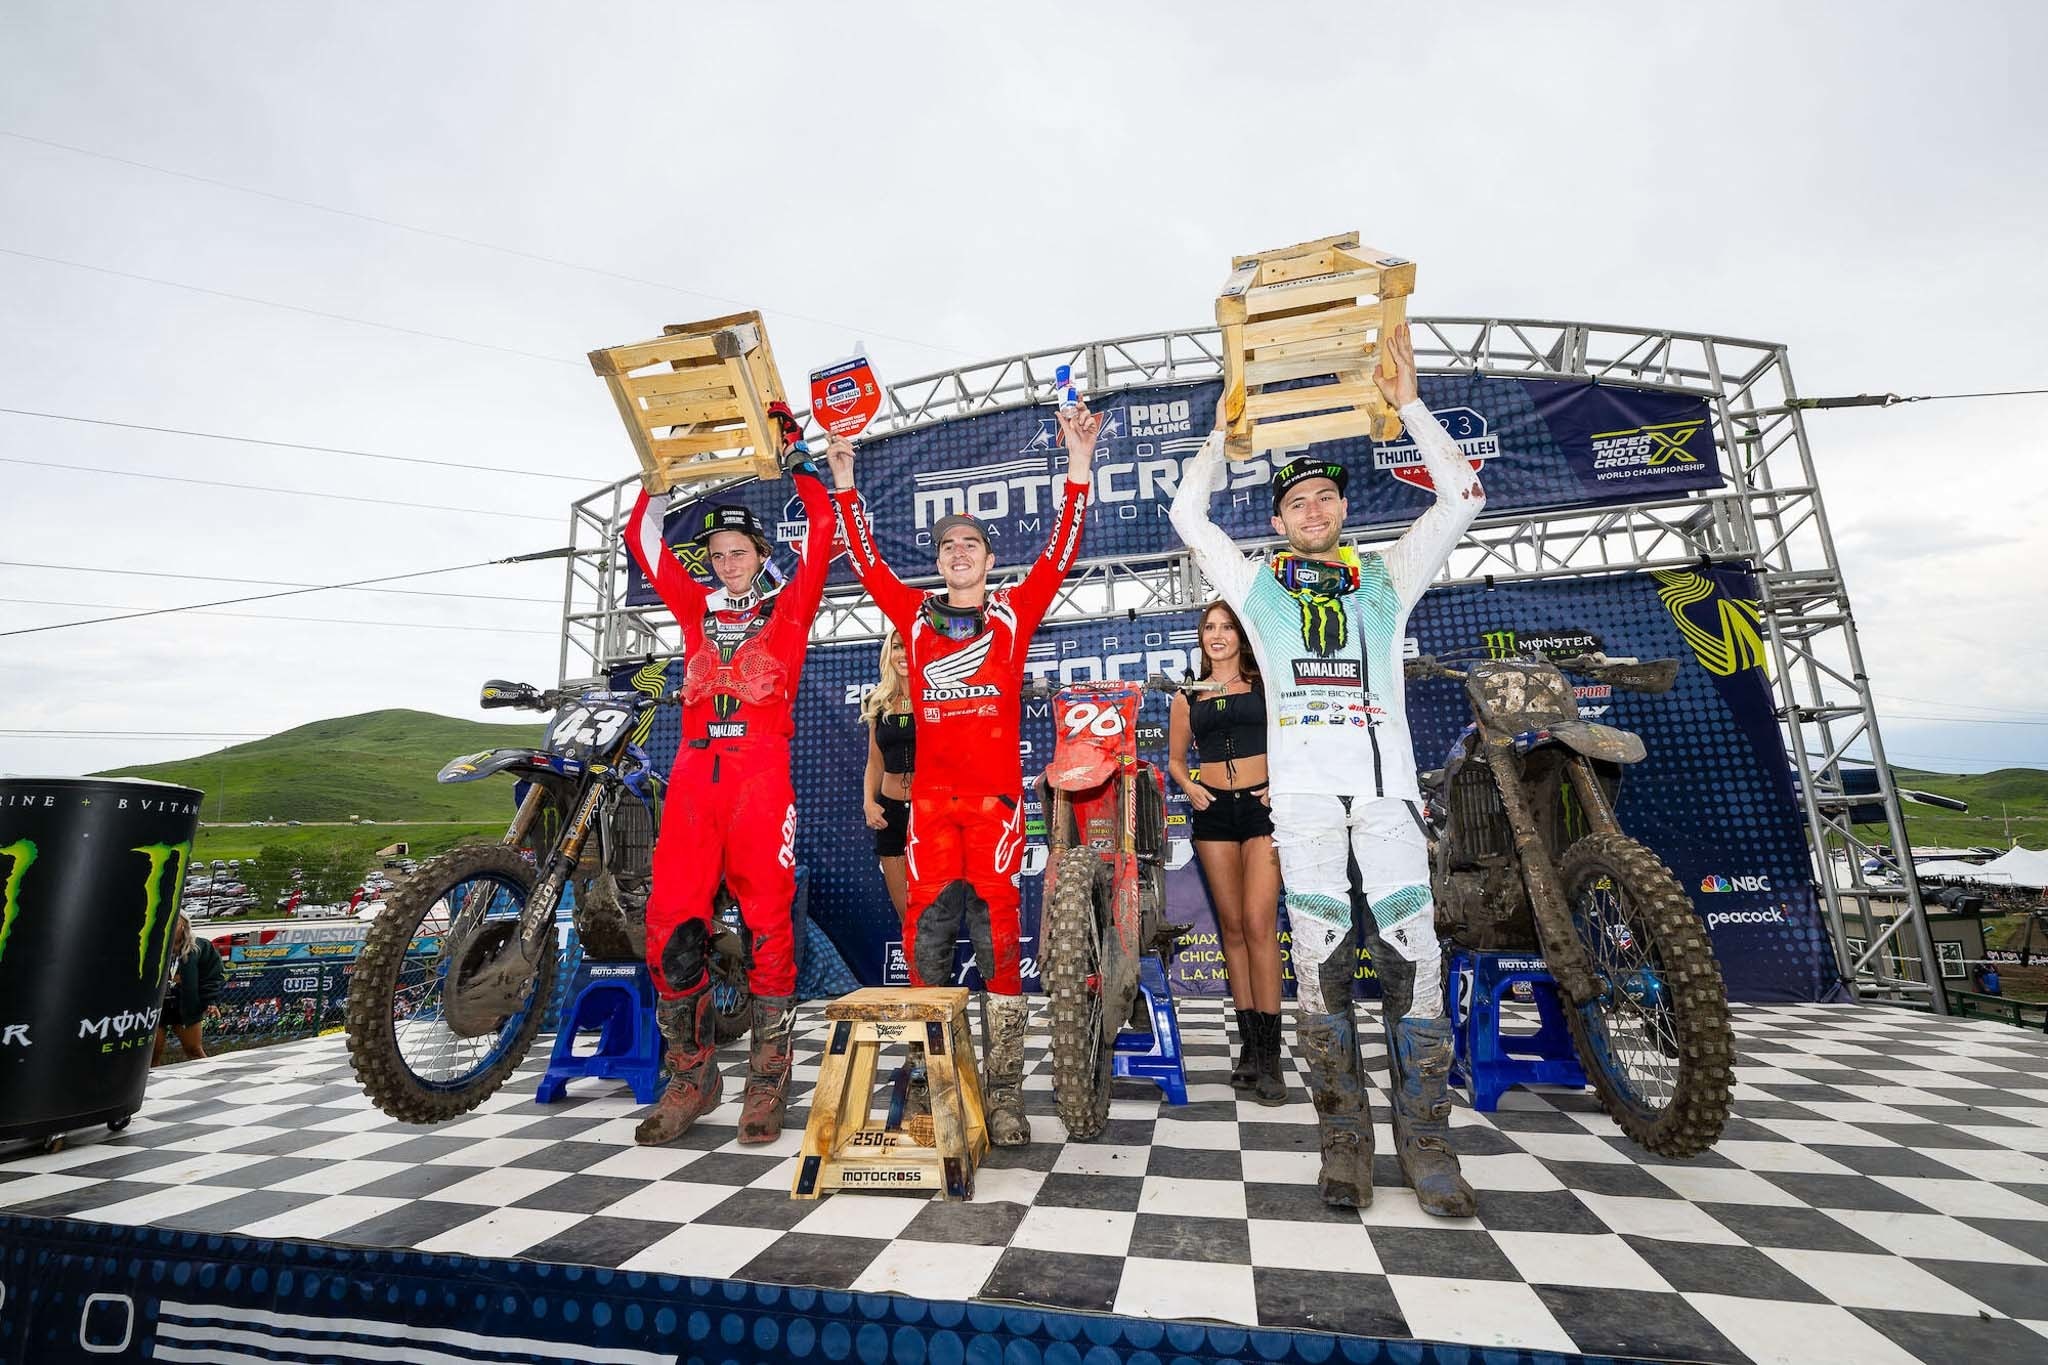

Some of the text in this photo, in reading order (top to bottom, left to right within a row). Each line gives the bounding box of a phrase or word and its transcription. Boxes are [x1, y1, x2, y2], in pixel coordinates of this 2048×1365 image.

[1130, 400, 1190, 426] PRO
[1132, 421, 1191, 437] RACING
[1592, 435, 1652, 451] SUPER
[1597, 445, 1650, 459] MOTO
[1594, 455, 1652, 469] CROSS
[1597, 463, 1706, 480] WORLD CHAMPIONSHIP
[914, 441, 1311, 530] MOTOCRSS
[850, 502, 876, 568] HONDA
[1045, 495, 1068, 560] HONDA
[716, 633, 746, 641] THOR
[1062, 633, 1162, 655] PRO
[1295, 662, 1358, 678] YAMALUBE
[922, 684, 1001, 701] HONDA
[1328, 690, 1380, 701] BICYCLES
[552, 707, 628, 746] 43
[1064, 703, 1127, 740] 96
[1731, 875, 1771, 892] NBC
[1707, 907, 1785, 930] peacock
[1178, 933, 1218, 945] zMAX
[1179, 951, 1227, 963] CHICA
[854, 1132, 897, 1147] 250cc
[842, 1171, 921, 1181] MOTOCROSS
